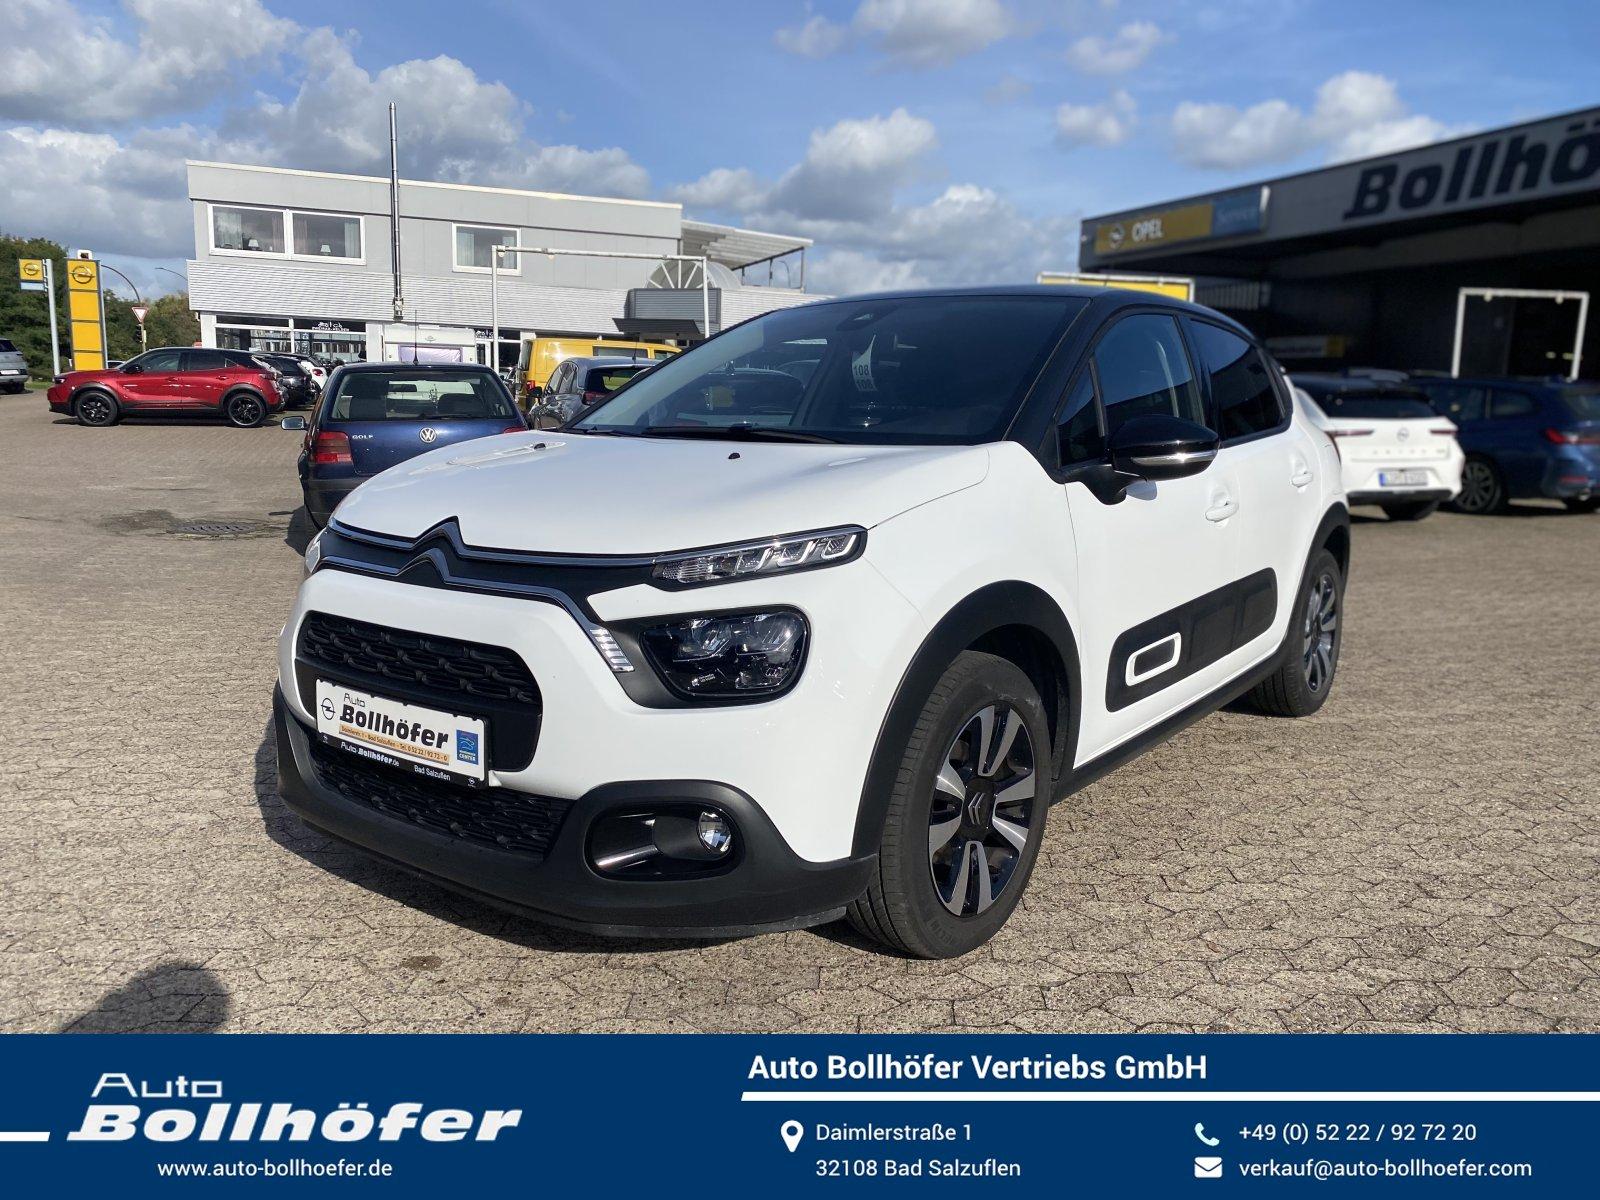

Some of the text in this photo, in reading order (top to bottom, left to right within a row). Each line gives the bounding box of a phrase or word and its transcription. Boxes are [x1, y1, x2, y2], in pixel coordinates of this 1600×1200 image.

[1131, 217, 1163, 243] OPEL
[854, 364, 869, 376] 108
[343, 692, 365, 708] Auto
[340, 703, 449, 749] Bollhöfer
[414, 764, 451, 781] Bad Salzuflen
